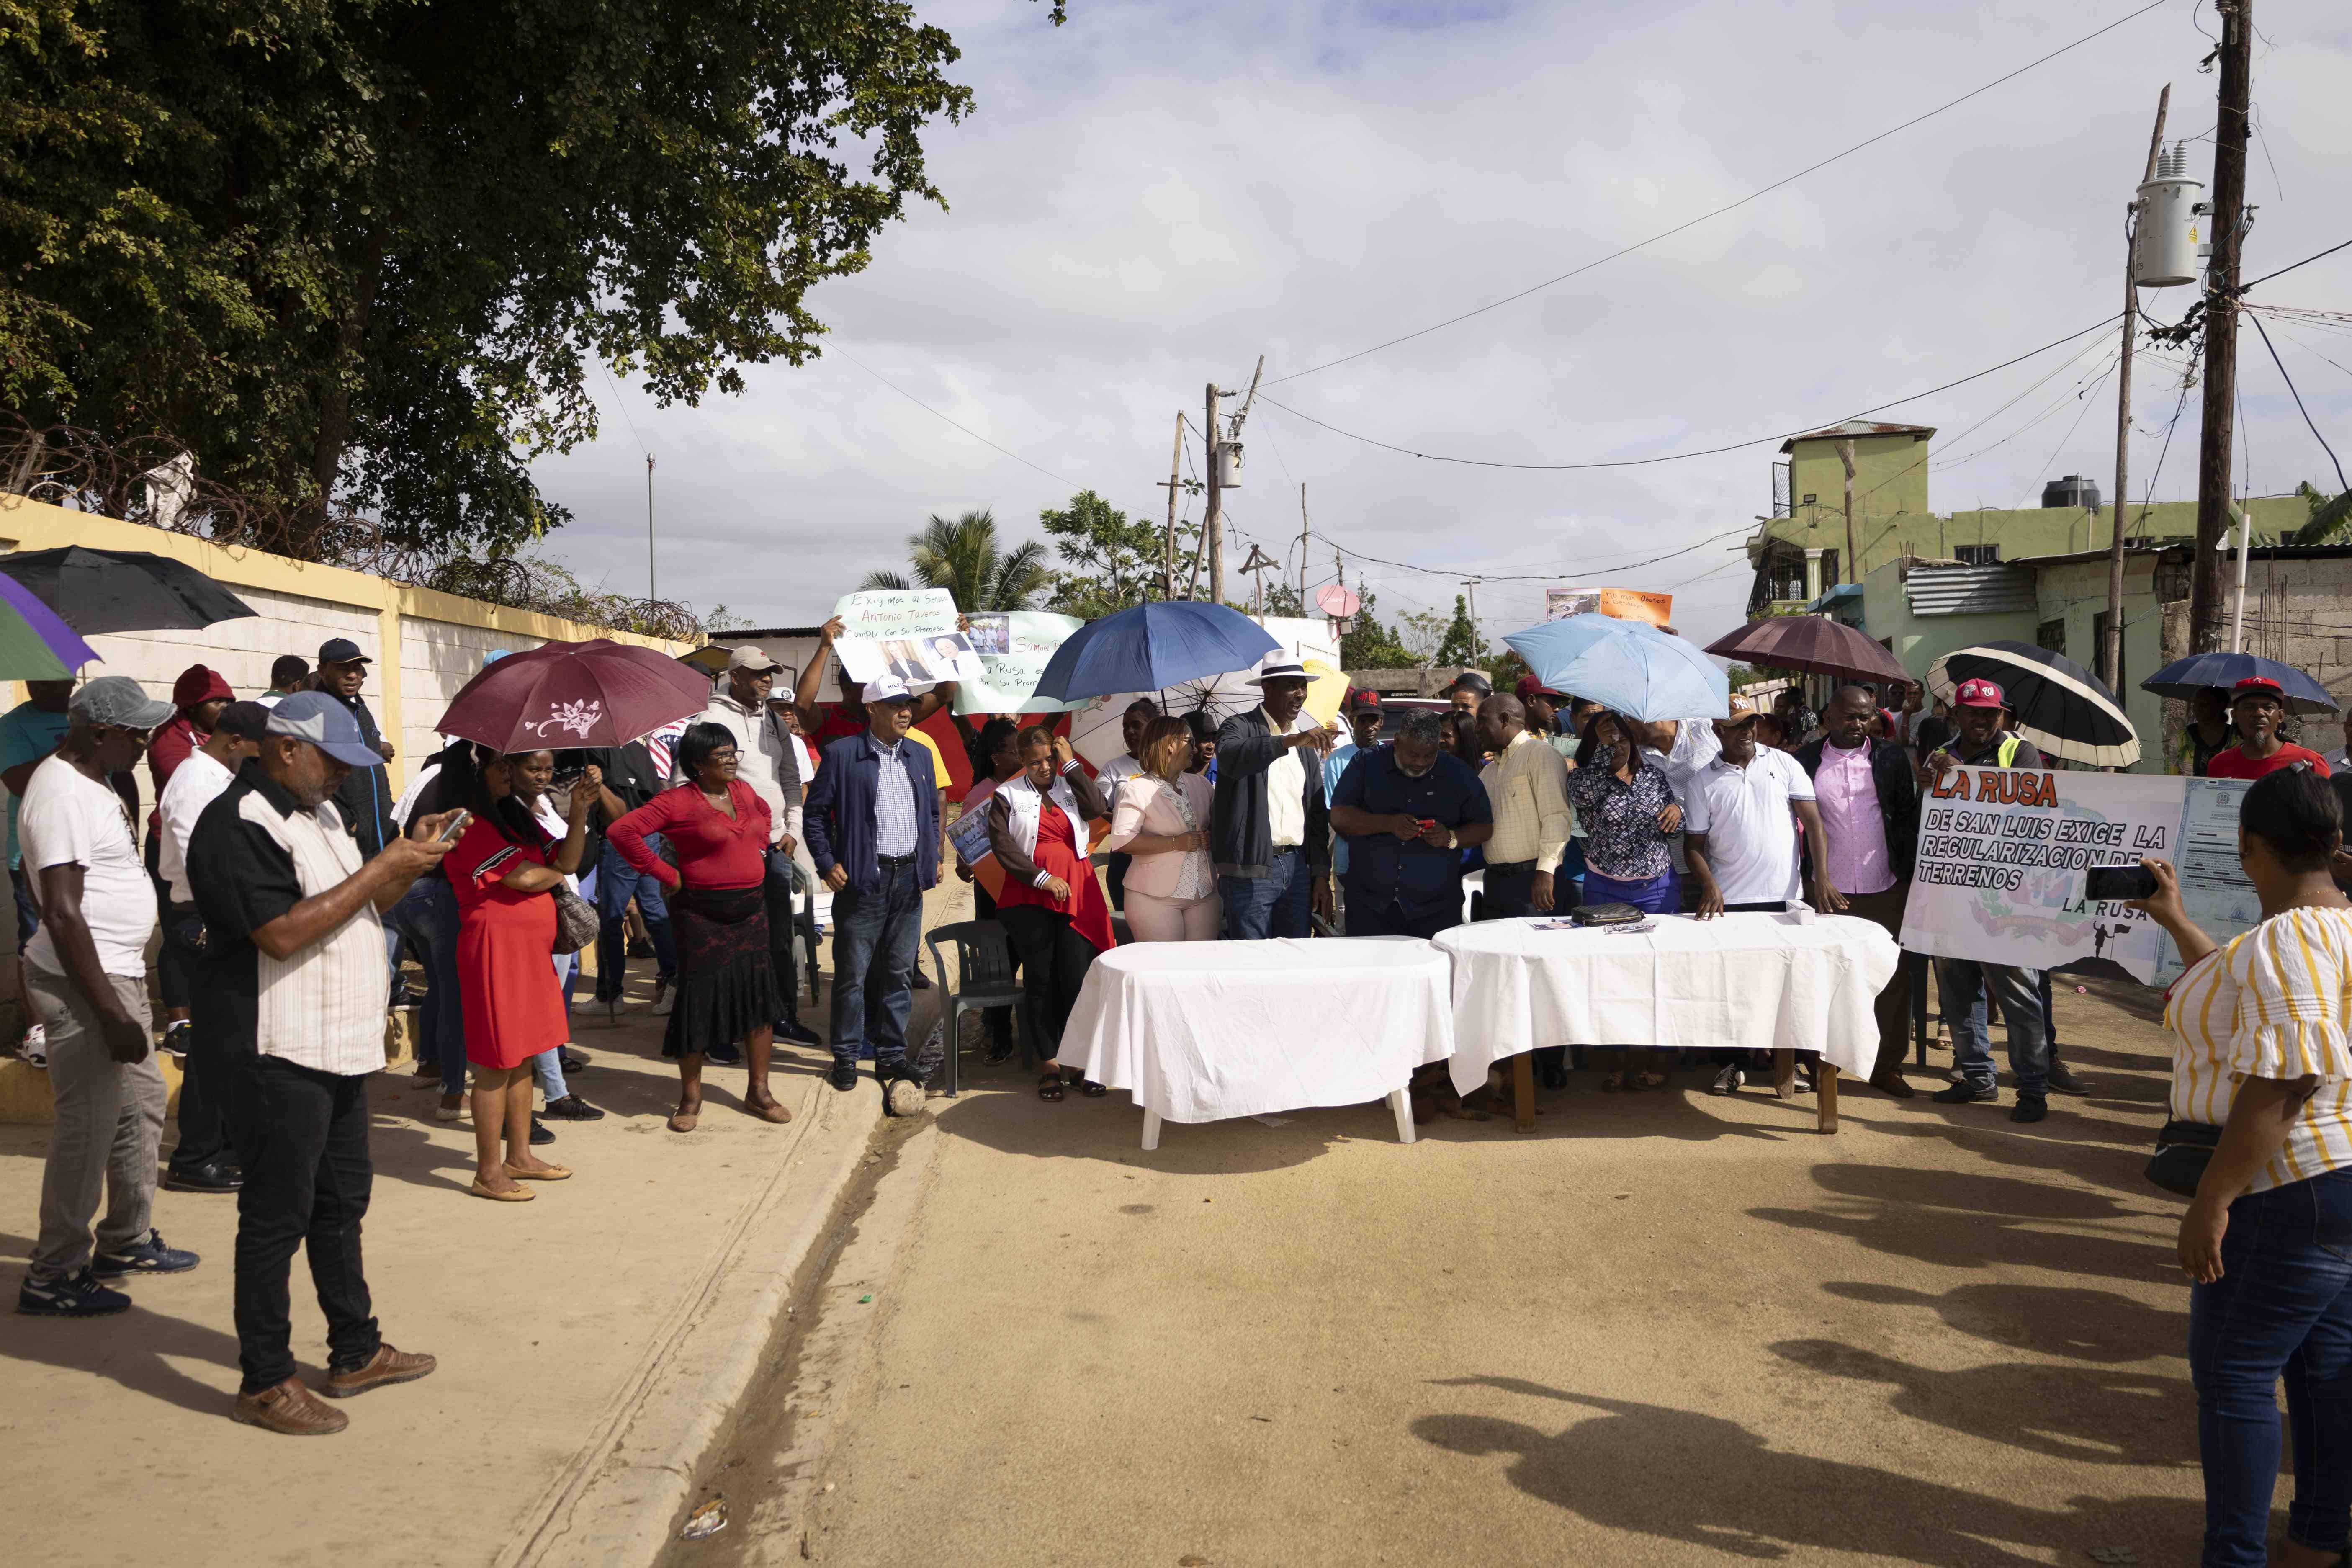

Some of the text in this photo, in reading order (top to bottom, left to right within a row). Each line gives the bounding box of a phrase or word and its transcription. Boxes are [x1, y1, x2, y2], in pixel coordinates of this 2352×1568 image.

[1052, 639, 1063, 650] P
[1015, 678, 1038, 687] Prom
[1931, 770, 2058, 807] LA RUSA
[1925, 809, 1954, 831] DE
[1954, 811, 2001, 834] SAN
[2002, 815, 2054, 840] LUIS
[2055, 819, 2126, 846] EXIGE
[2133, 825, 2165, 849] LA
[1921, 835, 2105, 870] REGULARIZACION
[1919, 860, 2024, 891] TERRENOS
[2062, 897, 2147, 921] LA RUSA
